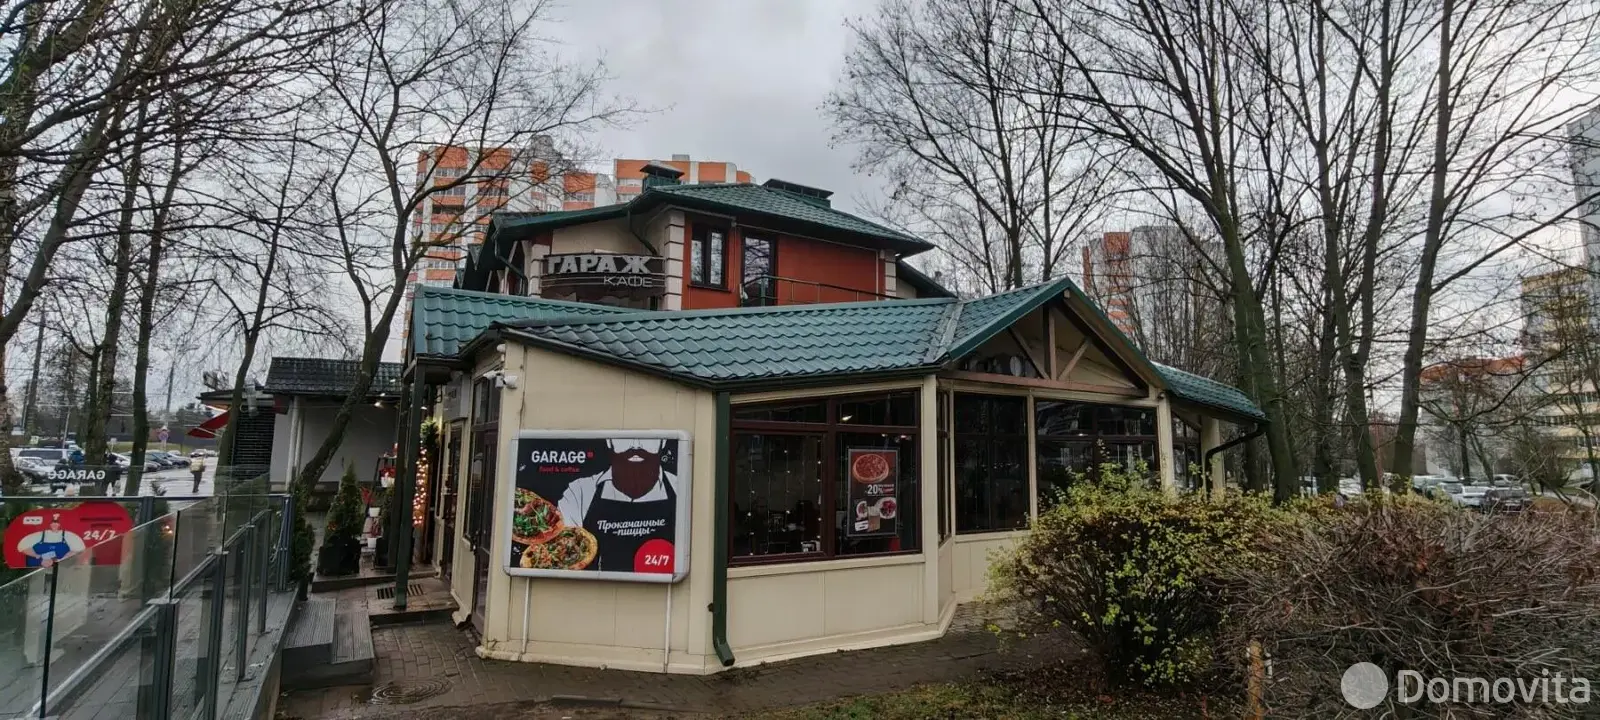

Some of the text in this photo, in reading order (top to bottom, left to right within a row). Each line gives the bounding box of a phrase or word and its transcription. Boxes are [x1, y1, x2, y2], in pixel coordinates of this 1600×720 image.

[547, 254, 652, 275] ГАРАЖ
[603, 275, 653, 287] КАФЕ
[539, 465, 554, 473] food
[597, 518, 666, 533] Прокачанные
[83, 529, 116, 541] 24/7
[644, 554, 670, 567] 24/7
